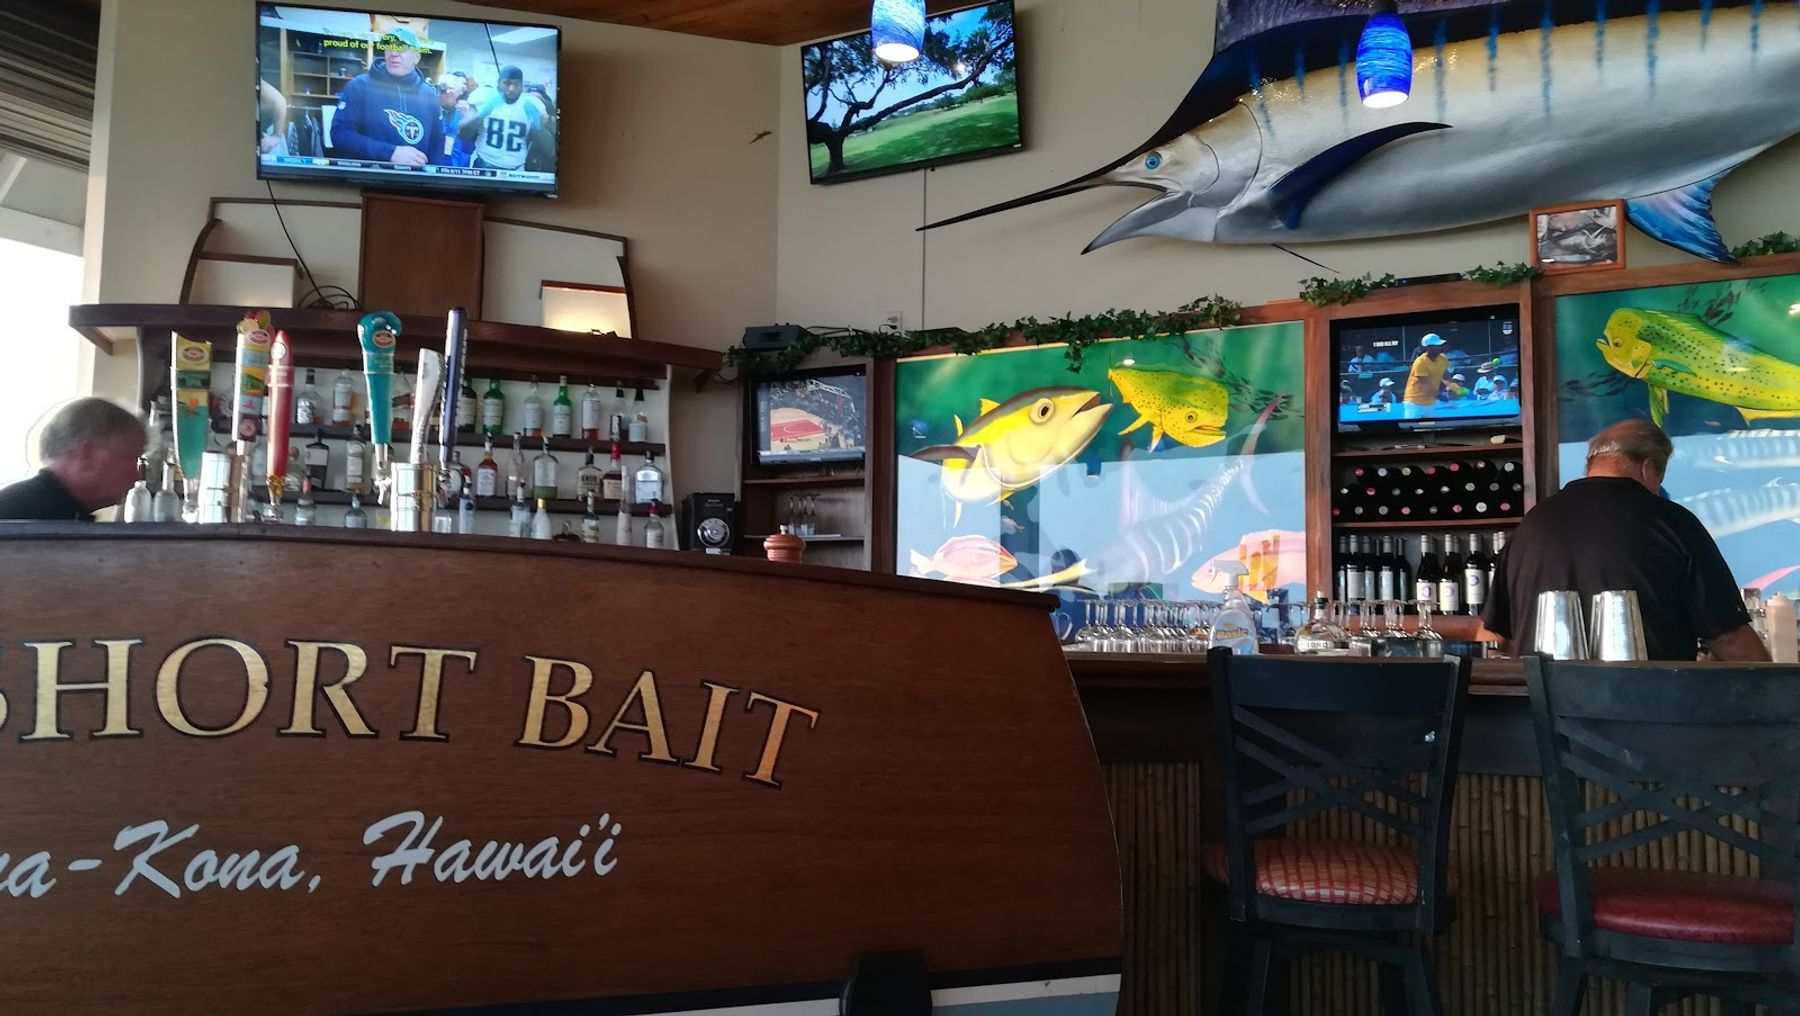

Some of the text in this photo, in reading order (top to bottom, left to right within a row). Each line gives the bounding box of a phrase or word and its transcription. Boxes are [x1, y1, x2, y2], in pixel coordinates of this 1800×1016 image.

[323, 39, 349, 48] proud
[349, 40, 360, 48] of
[486, 117, 527, 152] 82
[515, 652, 821, 789] BAIT
